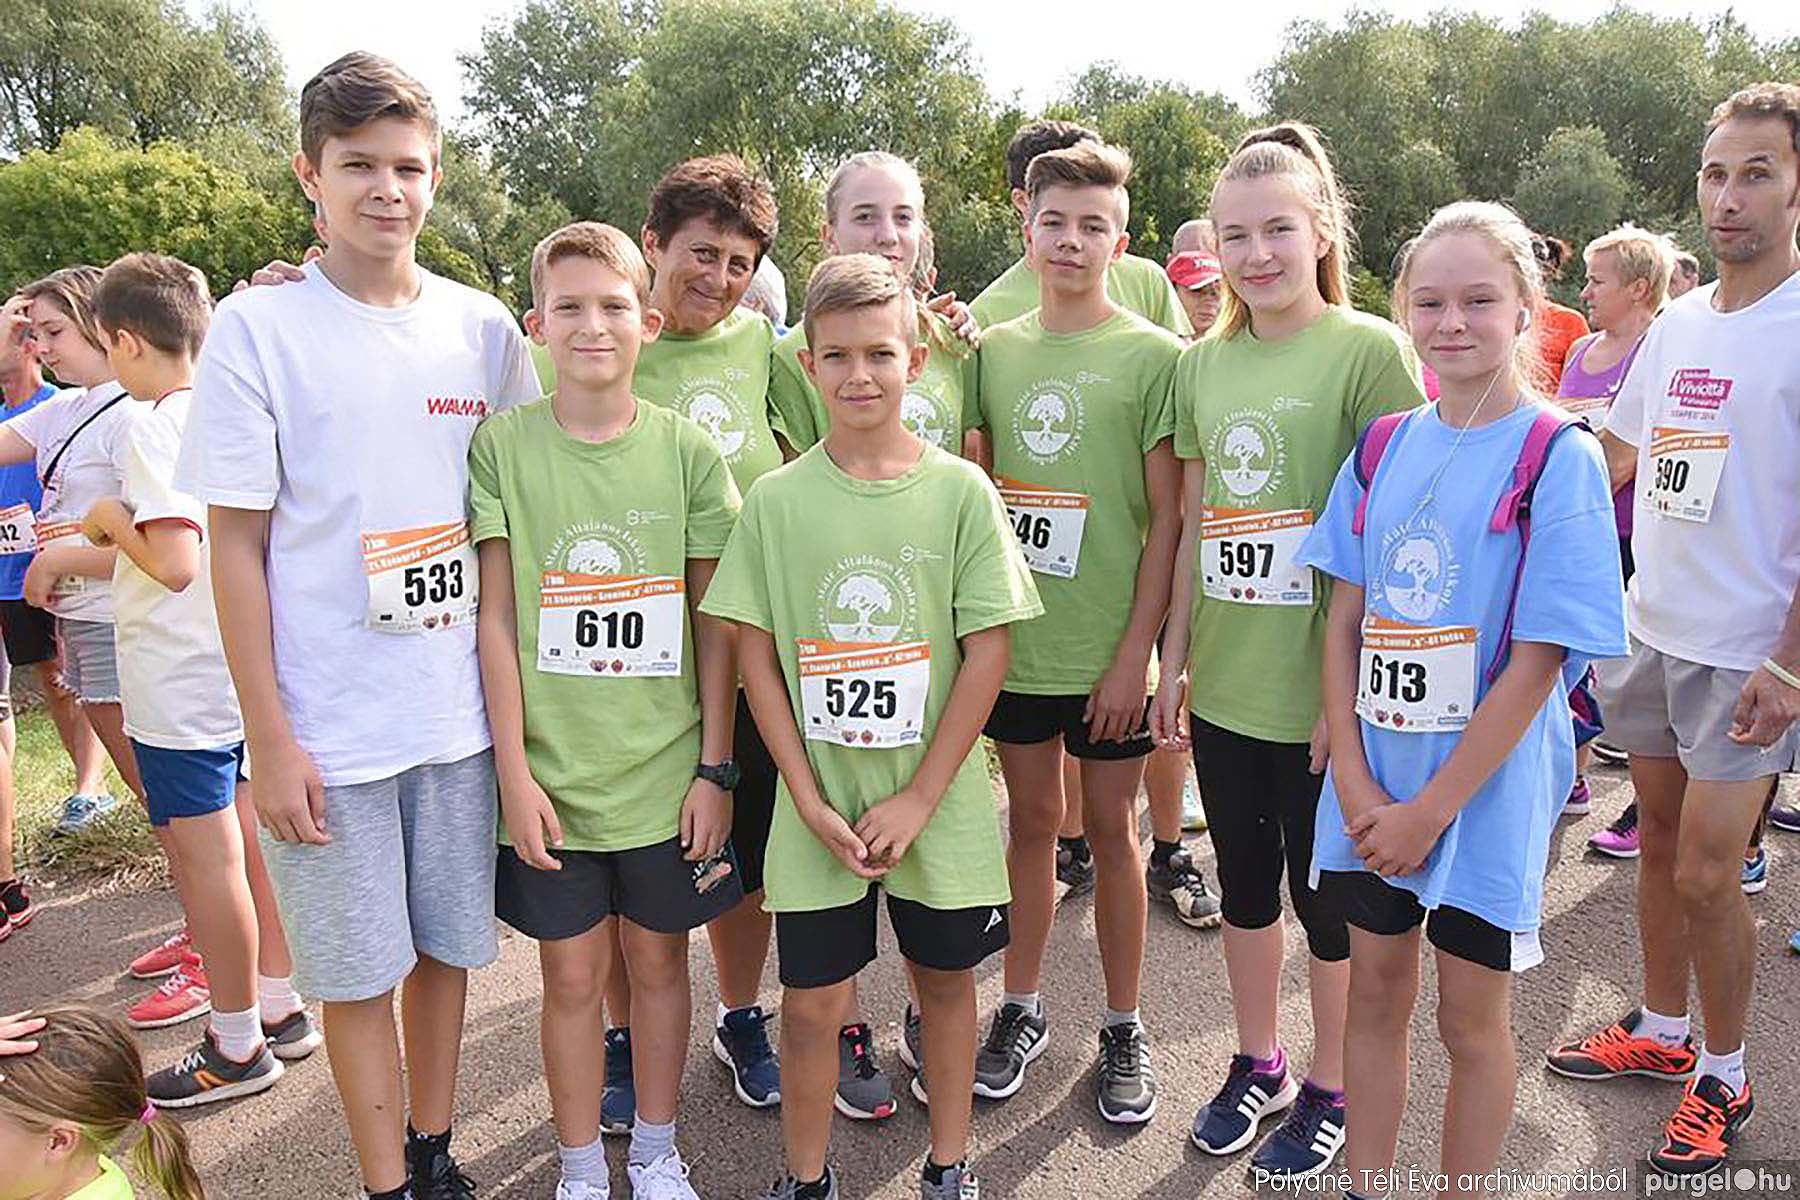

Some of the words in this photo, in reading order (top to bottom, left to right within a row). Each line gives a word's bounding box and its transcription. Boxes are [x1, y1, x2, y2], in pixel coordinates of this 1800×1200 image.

[1655, 458, 1690, 493] 590
[1219, 540, 1274, 578] 597
[404, 559, 464, 607] 533
[575, 609, 644, 650] 610
[1369, 653, 1427, 703] 613
[825, 678, 897, 720] 525
